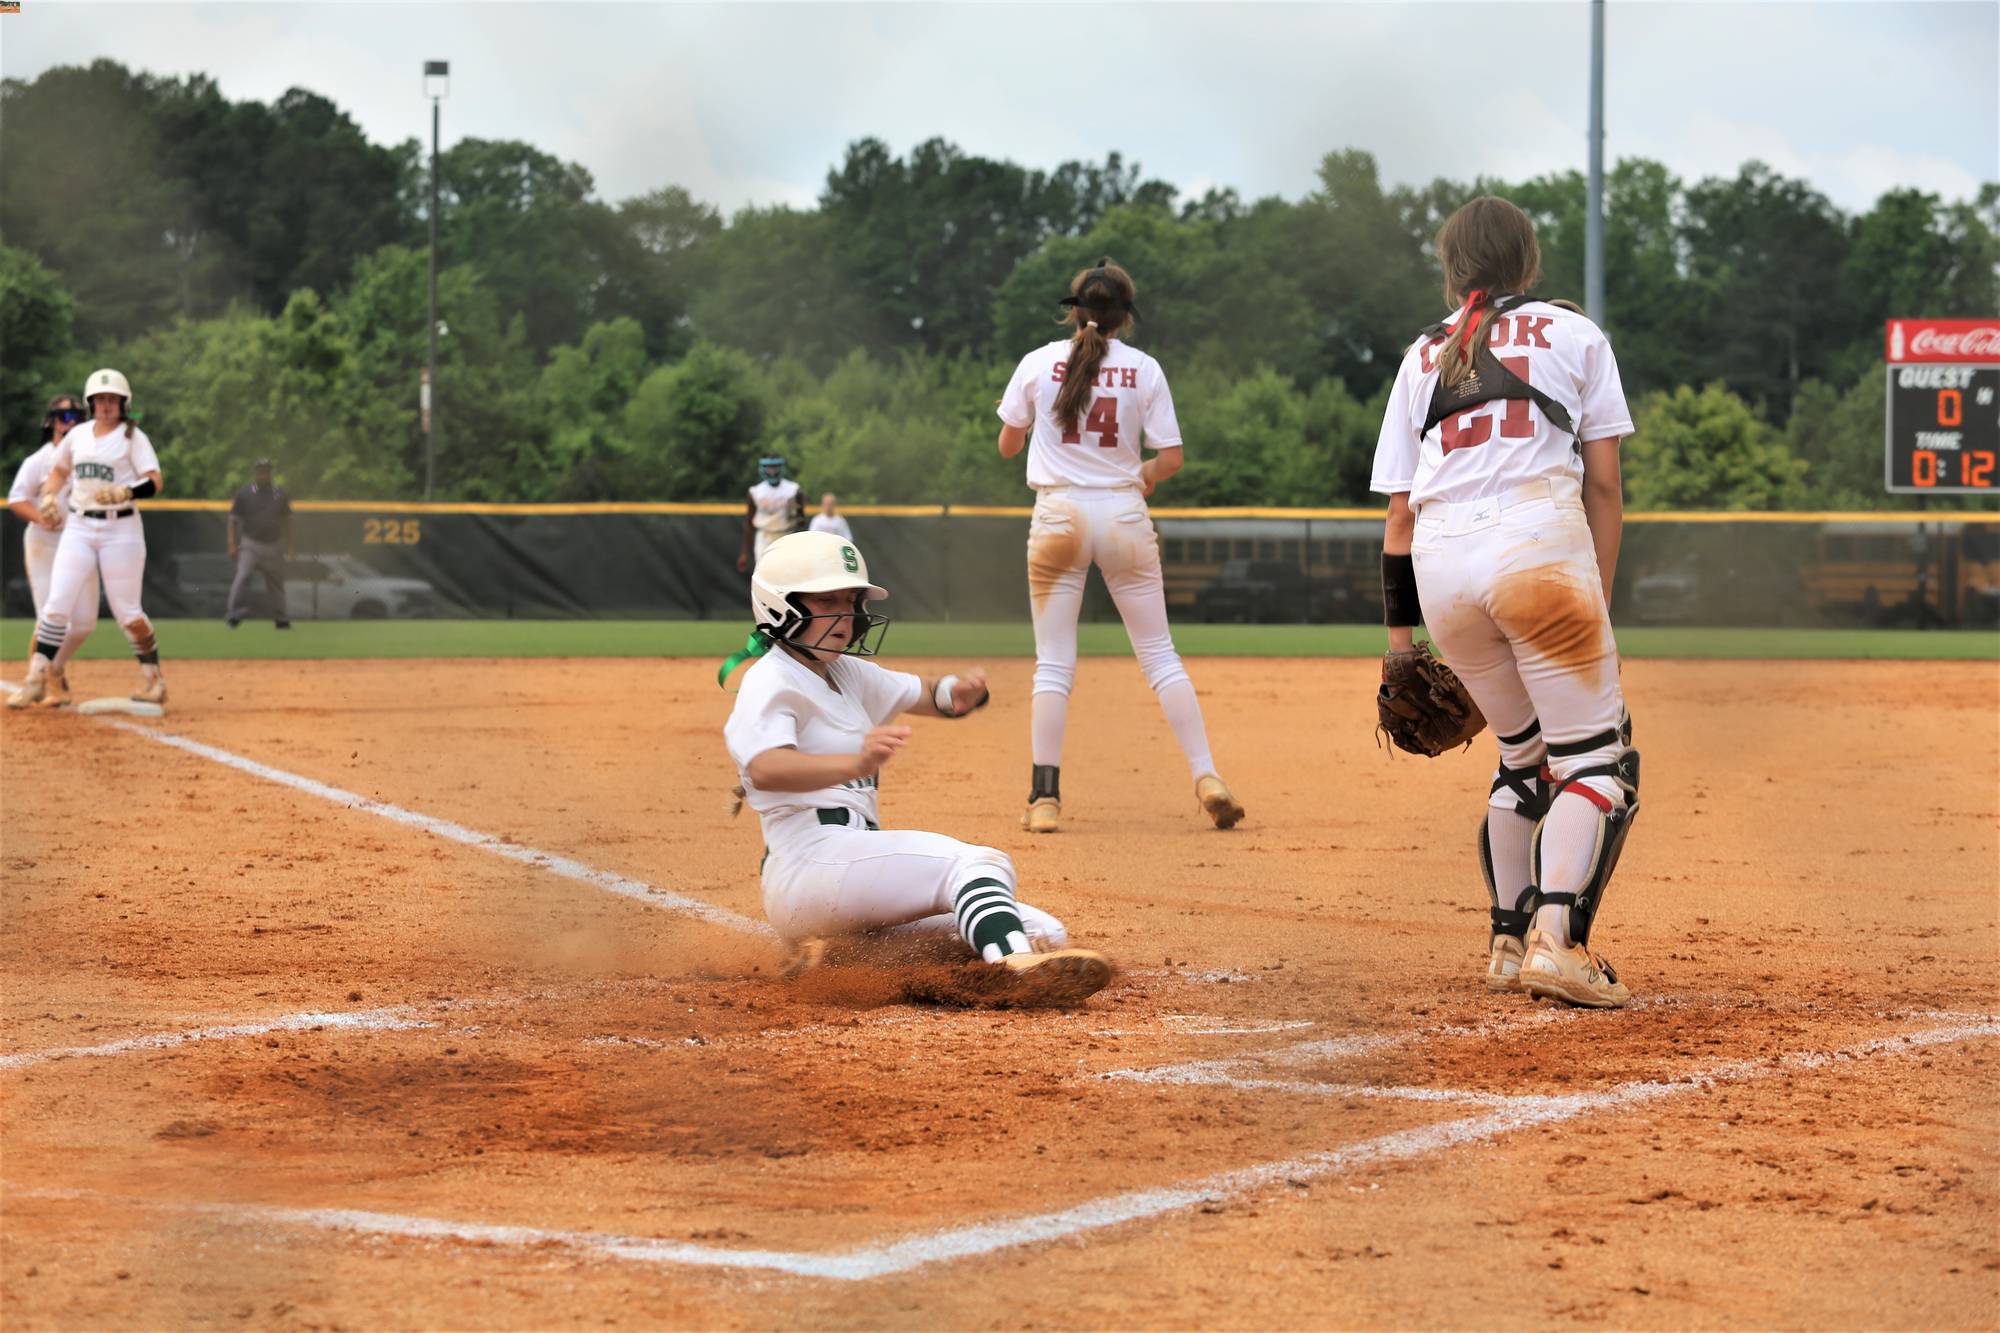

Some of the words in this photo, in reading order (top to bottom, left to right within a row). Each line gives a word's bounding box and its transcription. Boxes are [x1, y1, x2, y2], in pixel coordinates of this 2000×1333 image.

[1898, 366, 1976, 389] GUEST
[1937, 389, 1963, 426] 0
[1061, 396, 1119, 448] 14
[1915, 432, 1963, 450] TIME
[363, 518, 420, 545] 225
[841, 546, 858, 573] S
